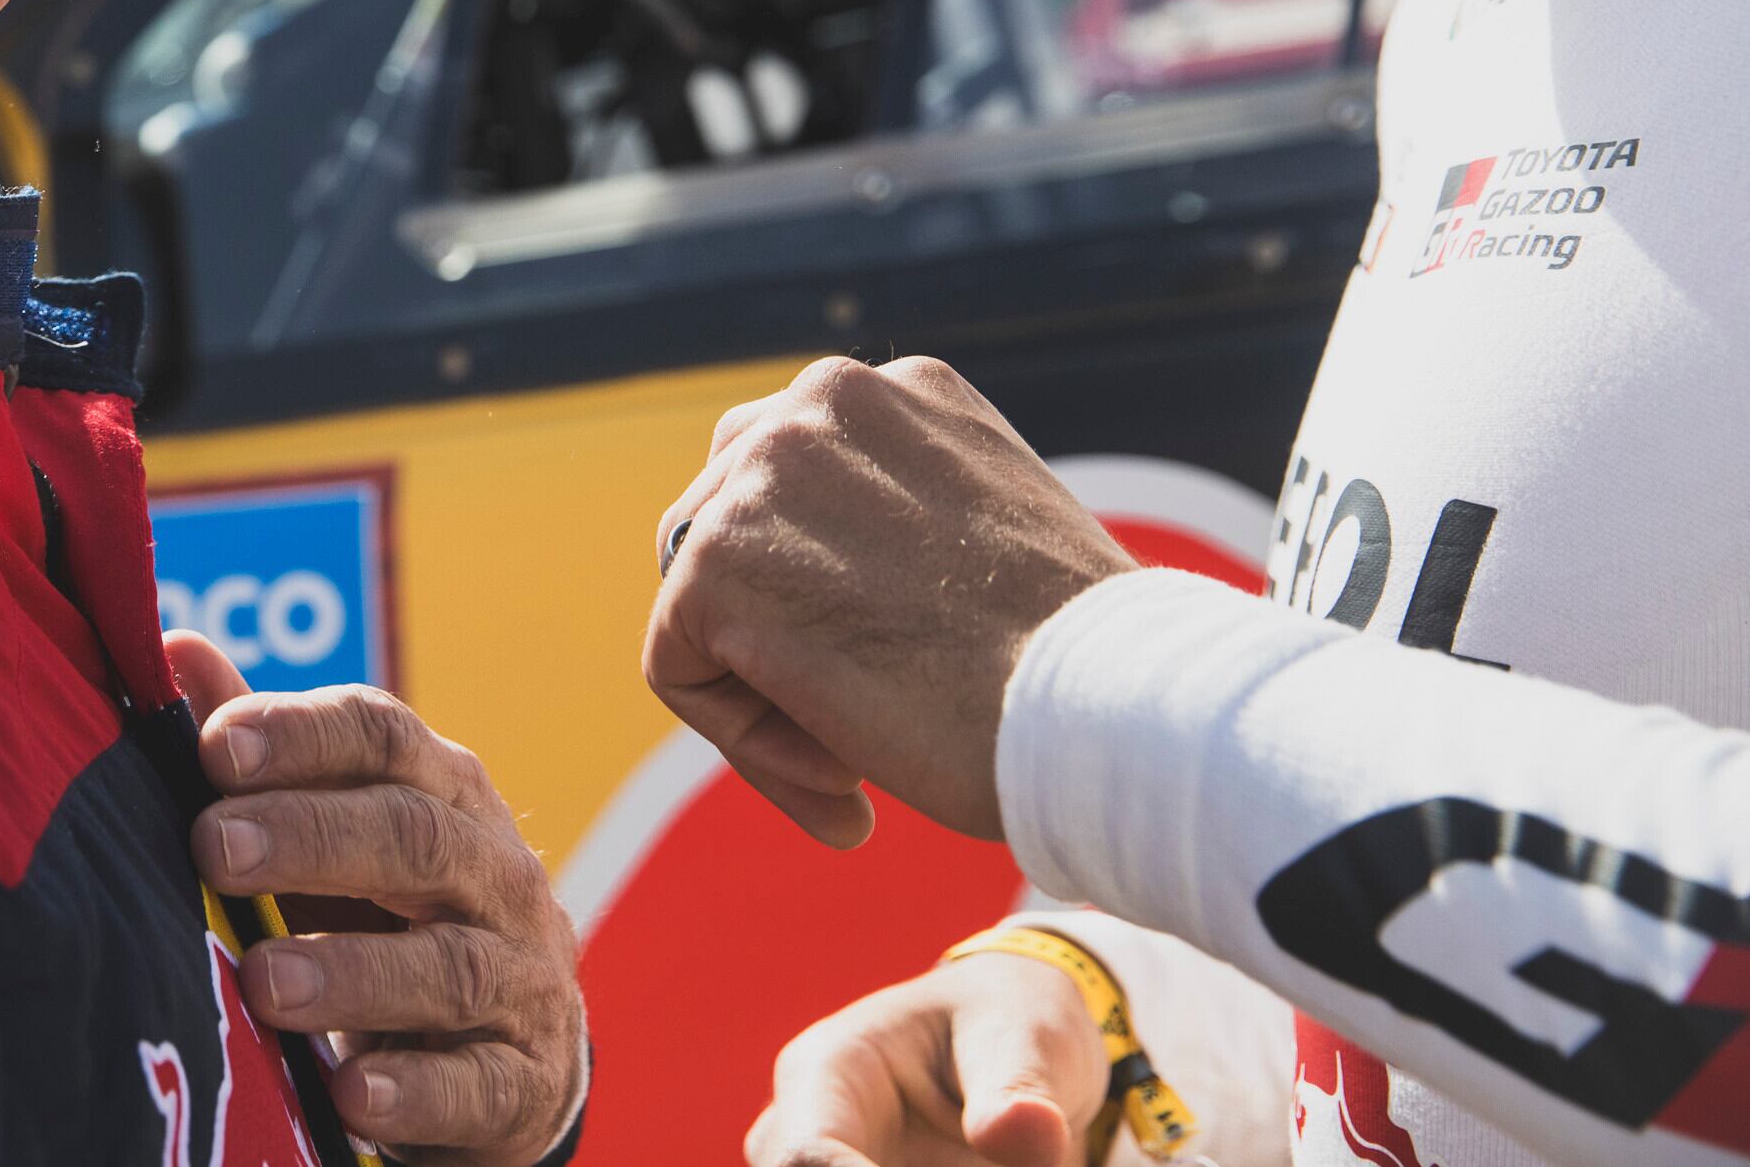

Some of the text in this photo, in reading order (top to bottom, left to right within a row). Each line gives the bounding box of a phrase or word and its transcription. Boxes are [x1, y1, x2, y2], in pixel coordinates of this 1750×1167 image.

[1501, 138, 1640, 181] TOYOTA
[1478, 185, 1606, 221] GAZOO
[1458, 225, 1582, 270] Racing
